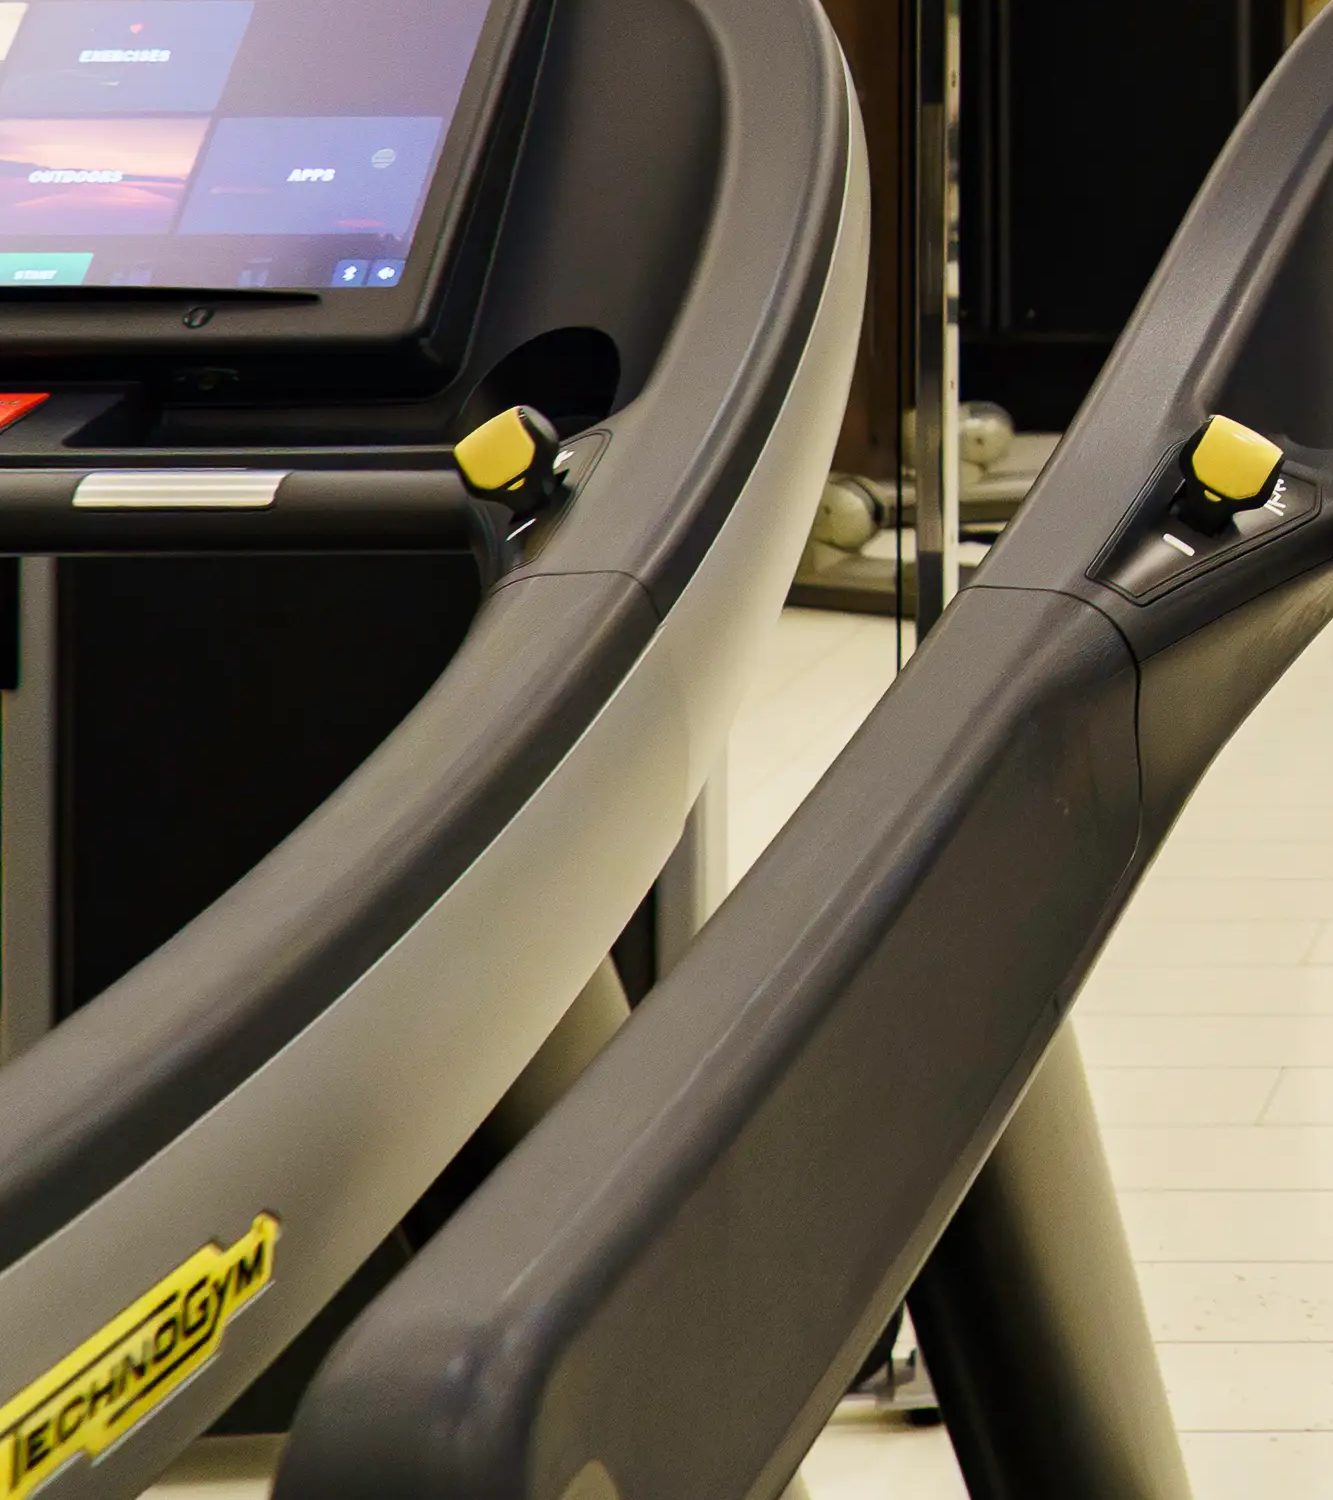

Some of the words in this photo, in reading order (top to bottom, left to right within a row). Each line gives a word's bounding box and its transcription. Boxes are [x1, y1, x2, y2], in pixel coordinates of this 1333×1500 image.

[79, 49, 171, 63] EXERCISES
[28, 169, 124, 184] OUTDOORS
[286, 168, 336, 182] APPS
